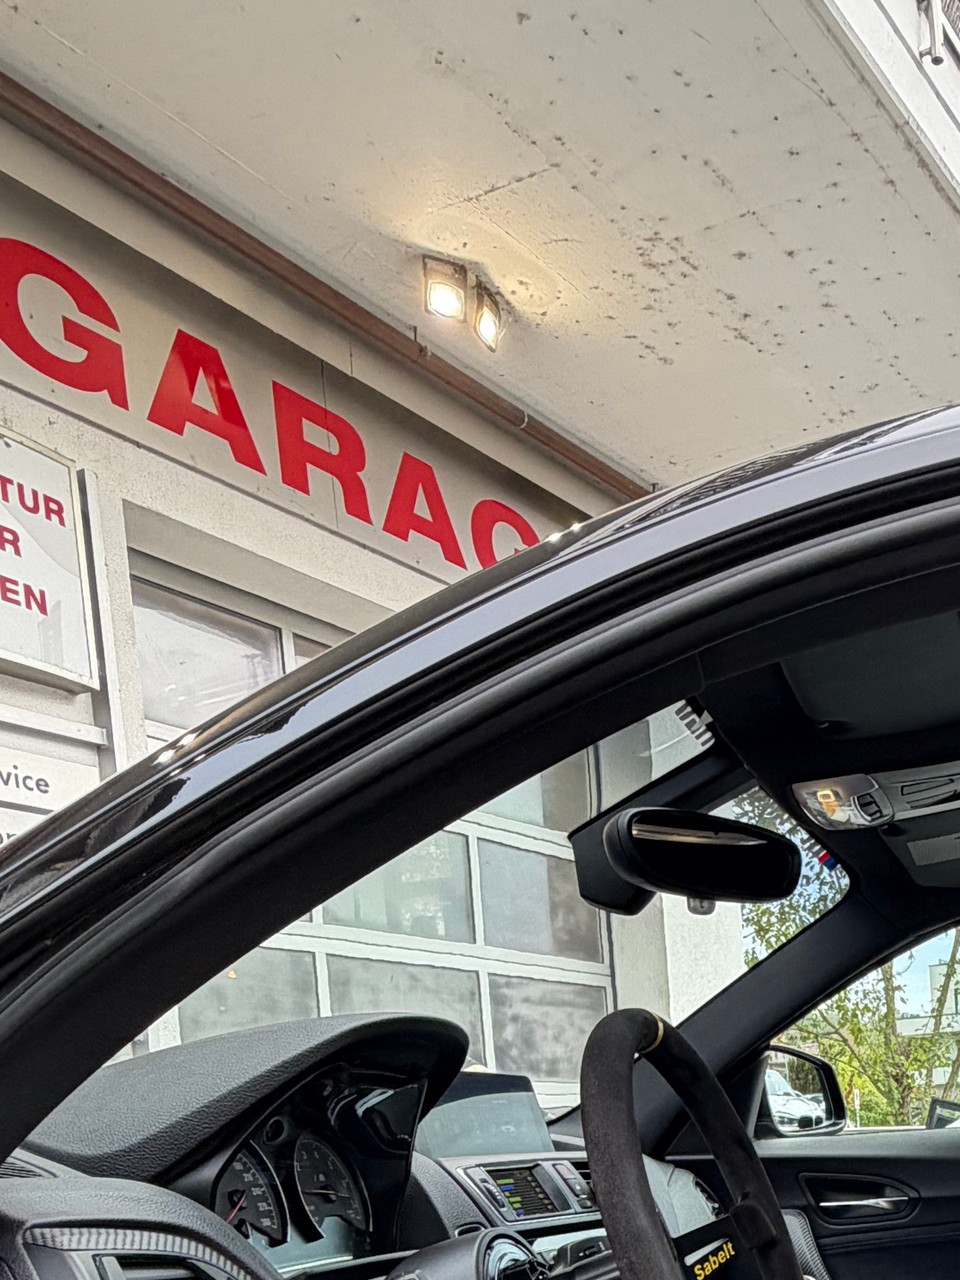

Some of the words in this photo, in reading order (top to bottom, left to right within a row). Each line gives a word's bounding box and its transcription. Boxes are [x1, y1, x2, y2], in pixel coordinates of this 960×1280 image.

[0, 474, 66, 528] TUR
[0, 574, 48, 616] EN
[0, 764, 50, 794] vice
[693, 1241, 735, 1280] Sabelt
